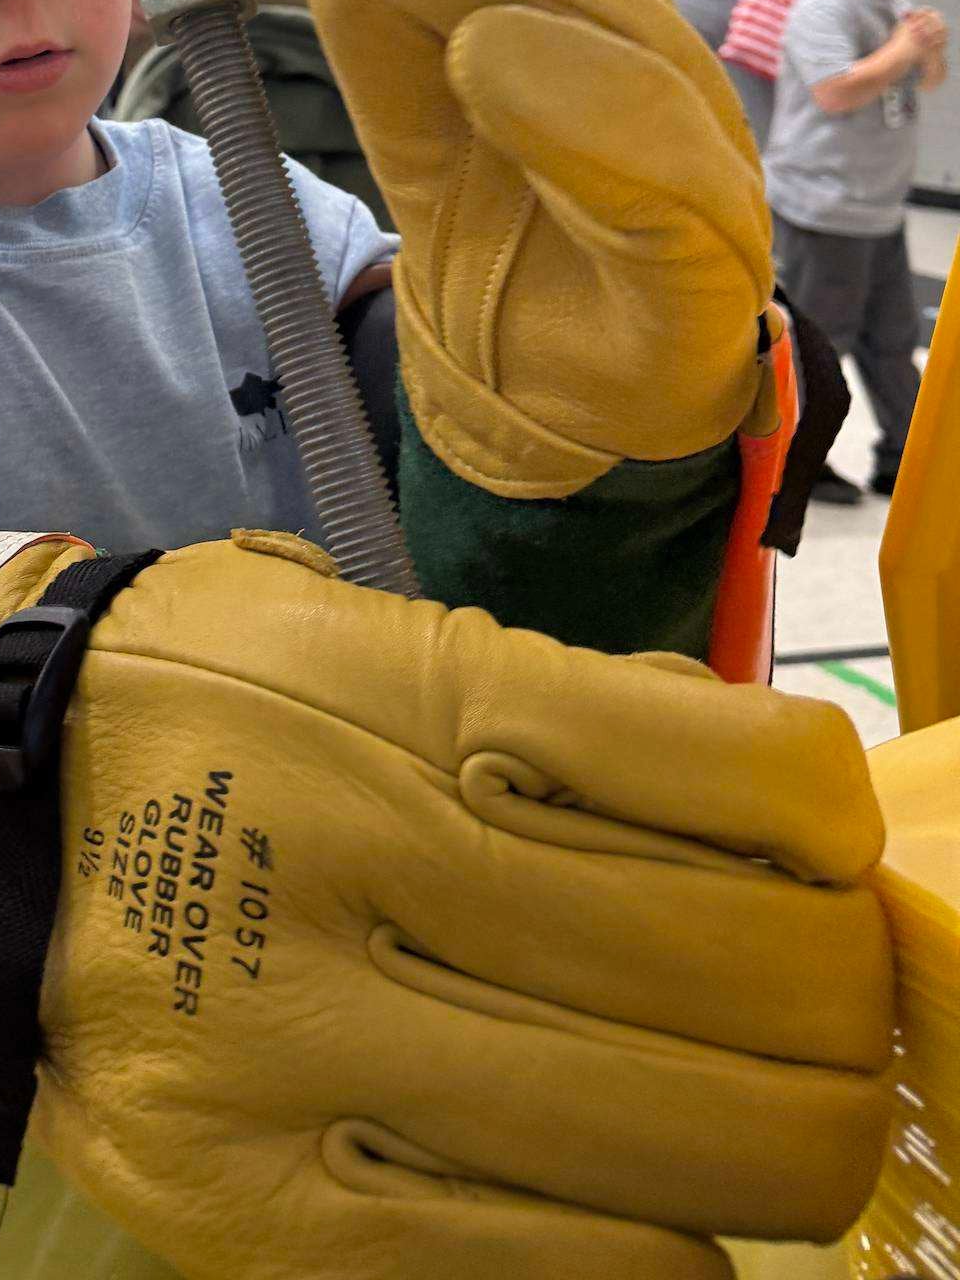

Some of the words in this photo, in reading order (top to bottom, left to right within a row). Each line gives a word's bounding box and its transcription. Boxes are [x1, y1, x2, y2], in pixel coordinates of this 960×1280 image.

[108, 811, 135, 900] SIZE
[124, 799, 161, 933] GLOVE
[148, 793, 192, 957] RUBBER
[189, 771, 233, 891] WEAR
[174, 902, 209, 1015] OVER
[231, 881, 269, 980] 1057
